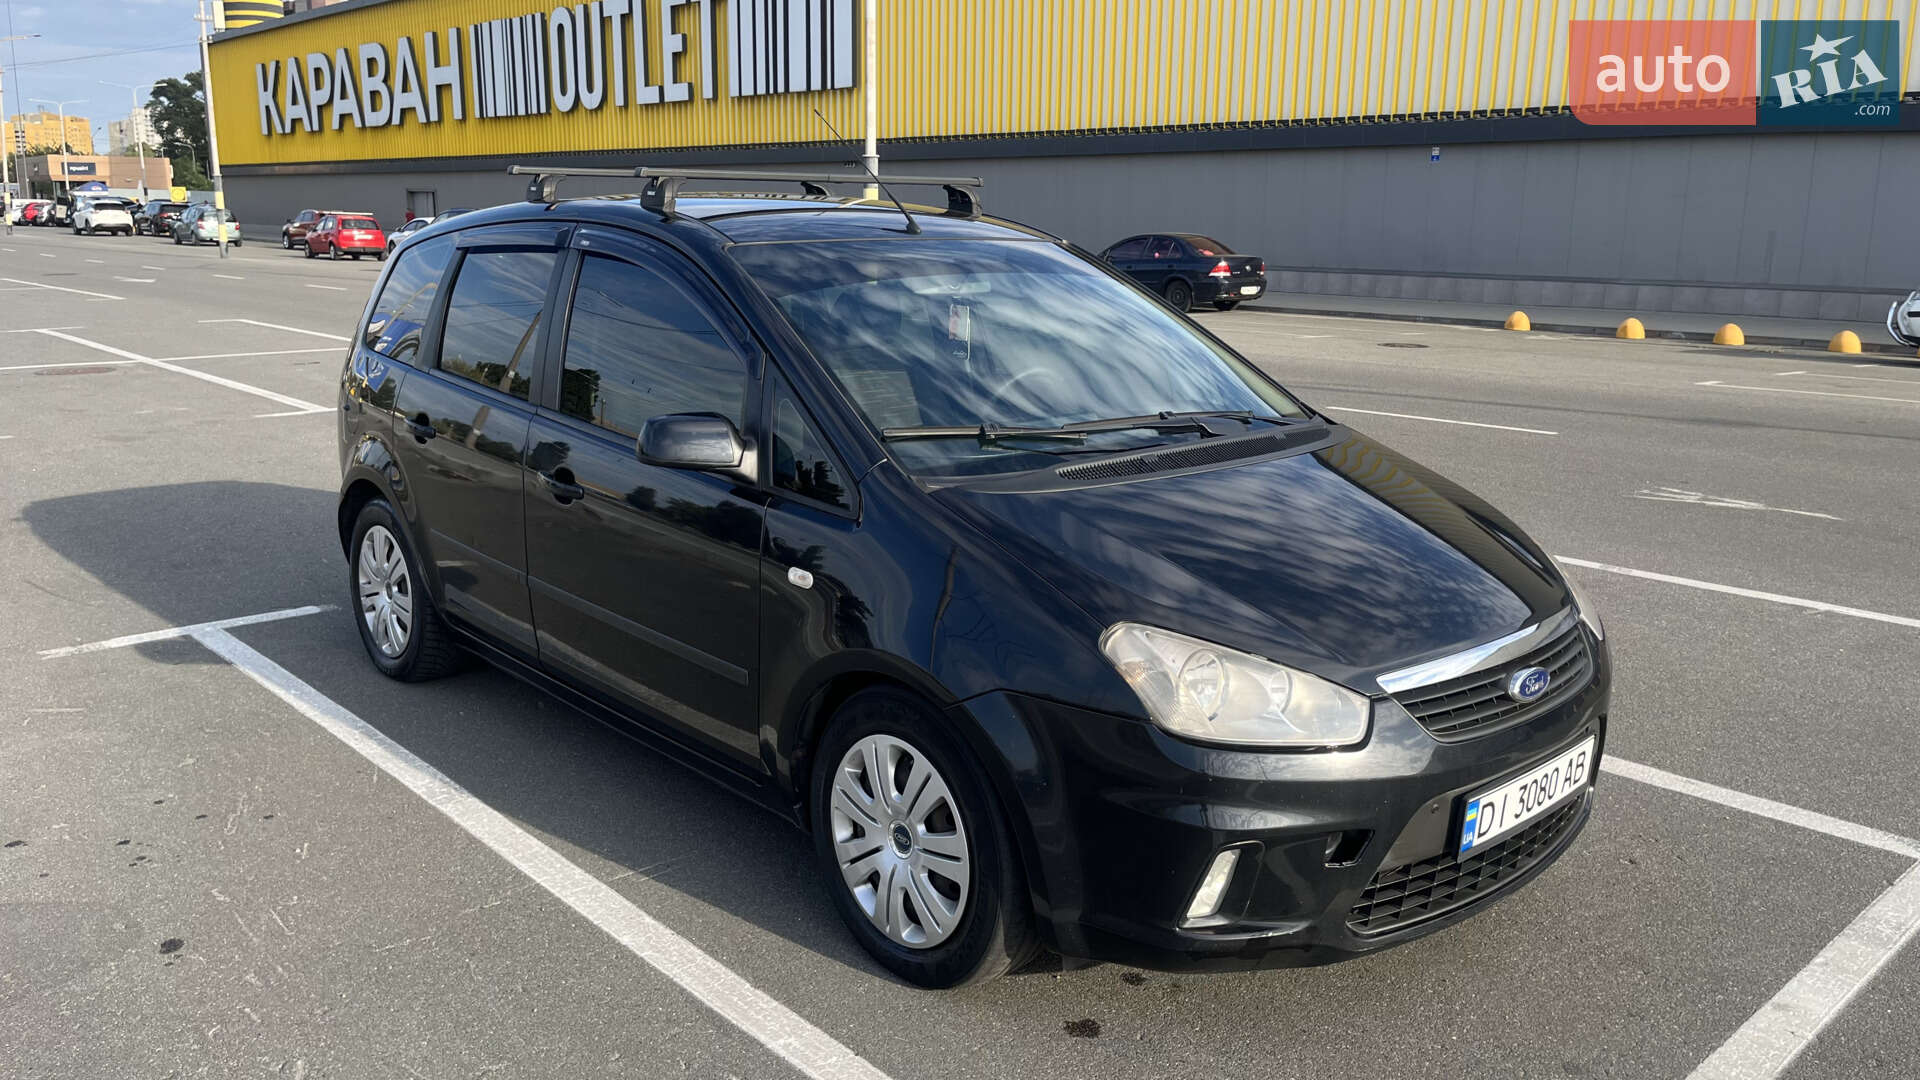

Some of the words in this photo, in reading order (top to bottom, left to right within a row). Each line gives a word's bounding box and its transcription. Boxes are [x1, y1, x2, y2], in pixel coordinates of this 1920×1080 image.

[255, 27, 462, 136] КАРАВАН
[549, 0, 716, 112] OUTLET
[1477, 793, 1508, 839] DI
[1514, 766, 1560, 819] 3080
[1561, 751, 1586, 793] AB
